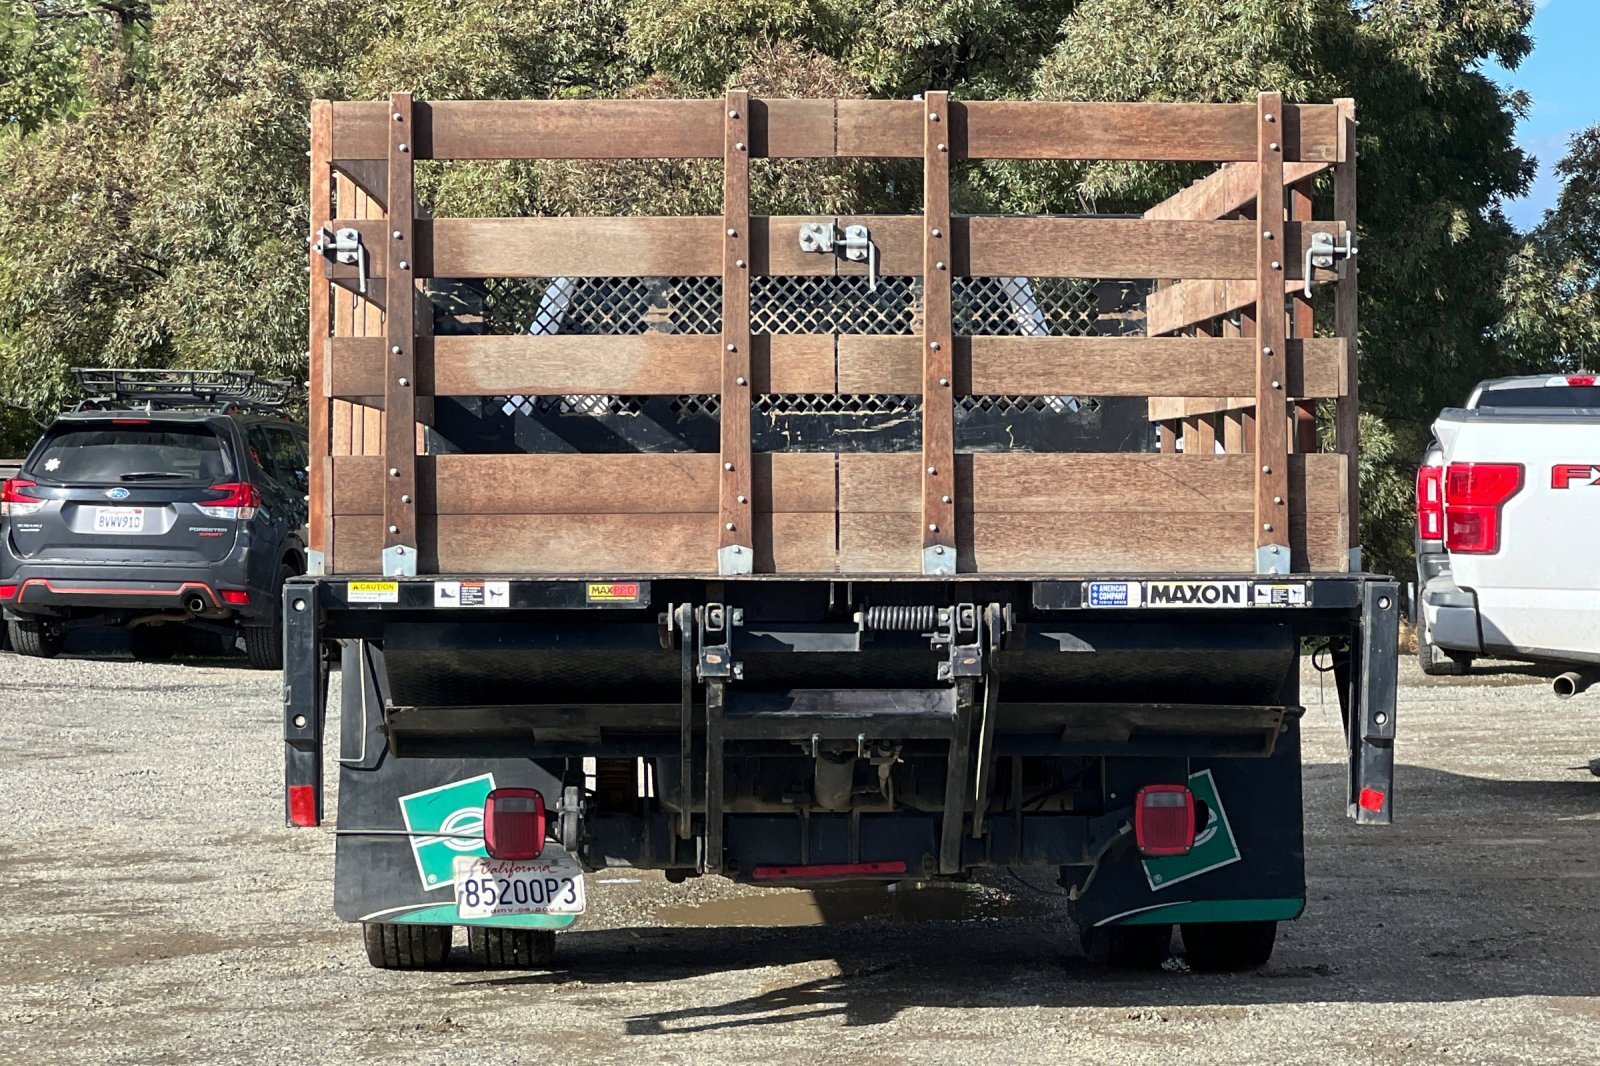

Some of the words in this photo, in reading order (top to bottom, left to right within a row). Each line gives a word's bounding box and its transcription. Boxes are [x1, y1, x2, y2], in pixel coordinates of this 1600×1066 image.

[360, 583, 395, 591] CAUTION
[1099, 584, 1127, 592] AMERICAN
[1099, 592, 1127, 600] COMPANY
[1150, 584, 1241, 604] MAXON
[481, 860, 552, 878] California
[464, 878, 577, 907] 85200P3
